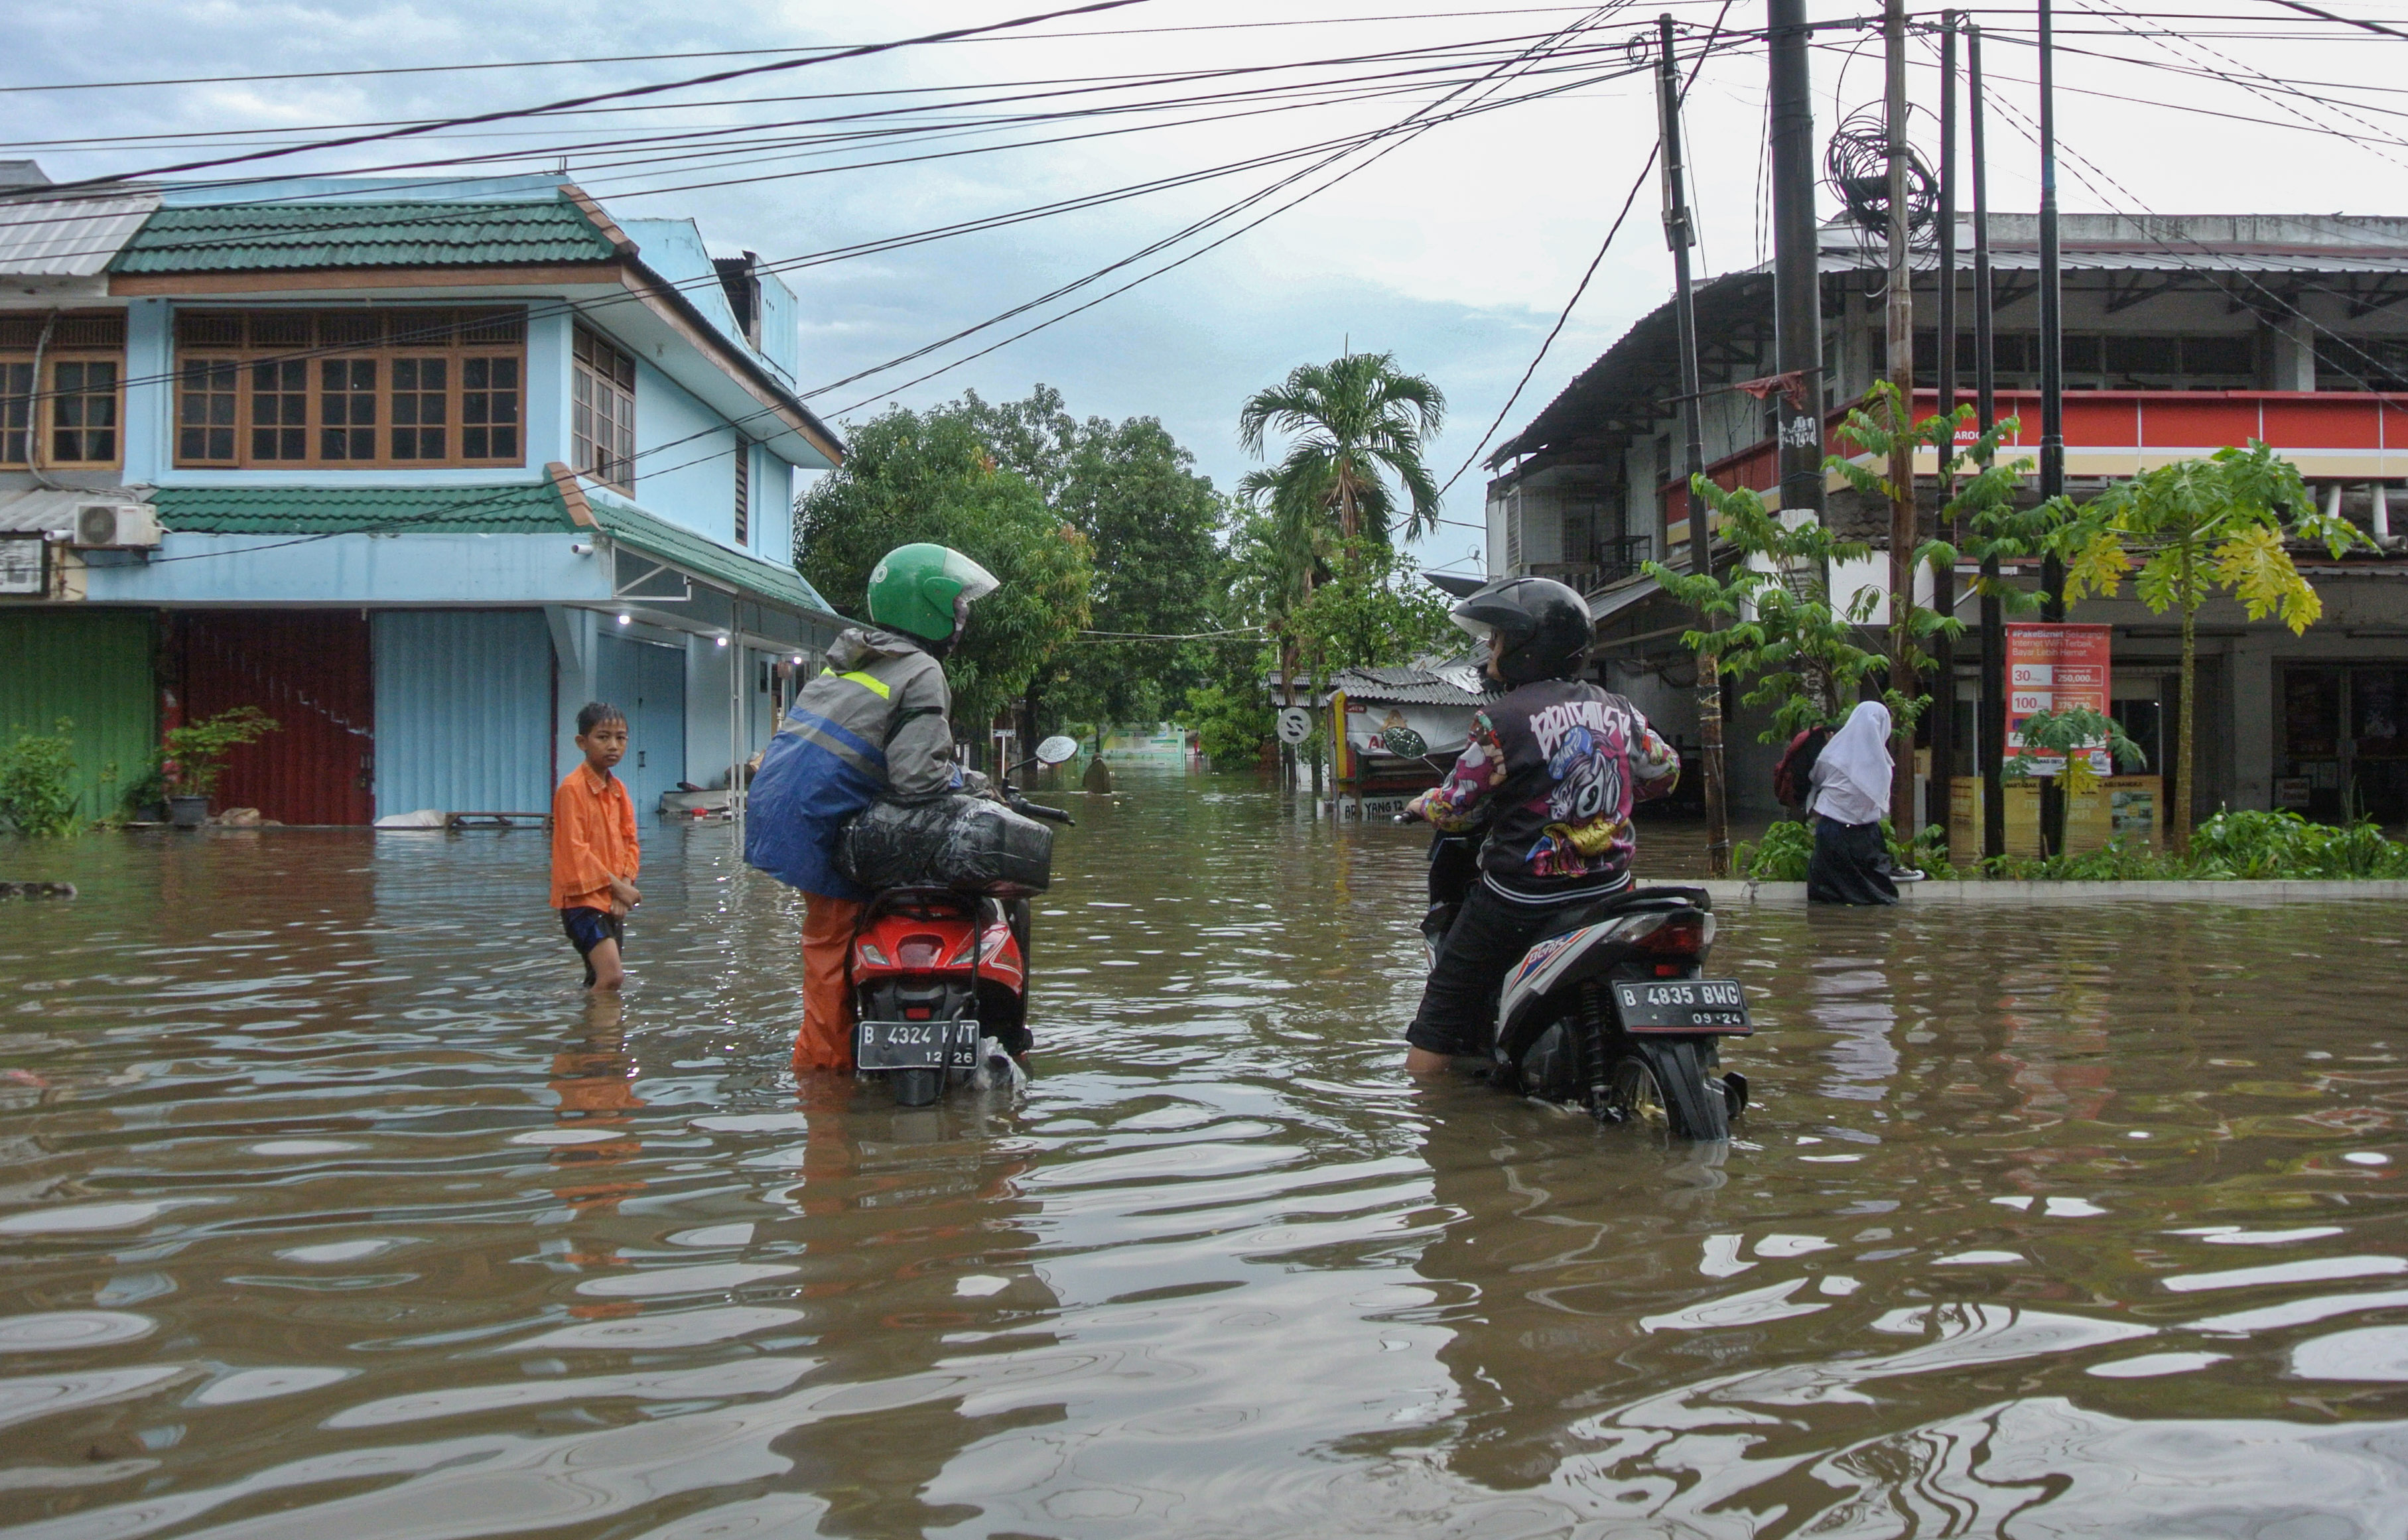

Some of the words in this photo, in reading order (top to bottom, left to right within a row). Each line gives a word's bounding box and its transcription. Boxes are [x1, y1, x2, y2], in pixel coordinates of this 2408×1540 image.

[2015, 670, 2031, 682] 30
[2015, 697, 2038, 709] 100
[1623, 989, 1637, 1007] B
[1648, 986, 1694, 1005] 4835
[1702, 986, 1739, 1005] BWG
[864, 1026, 874, 1044] B
[887, 1026, 931, 1045] 4324
